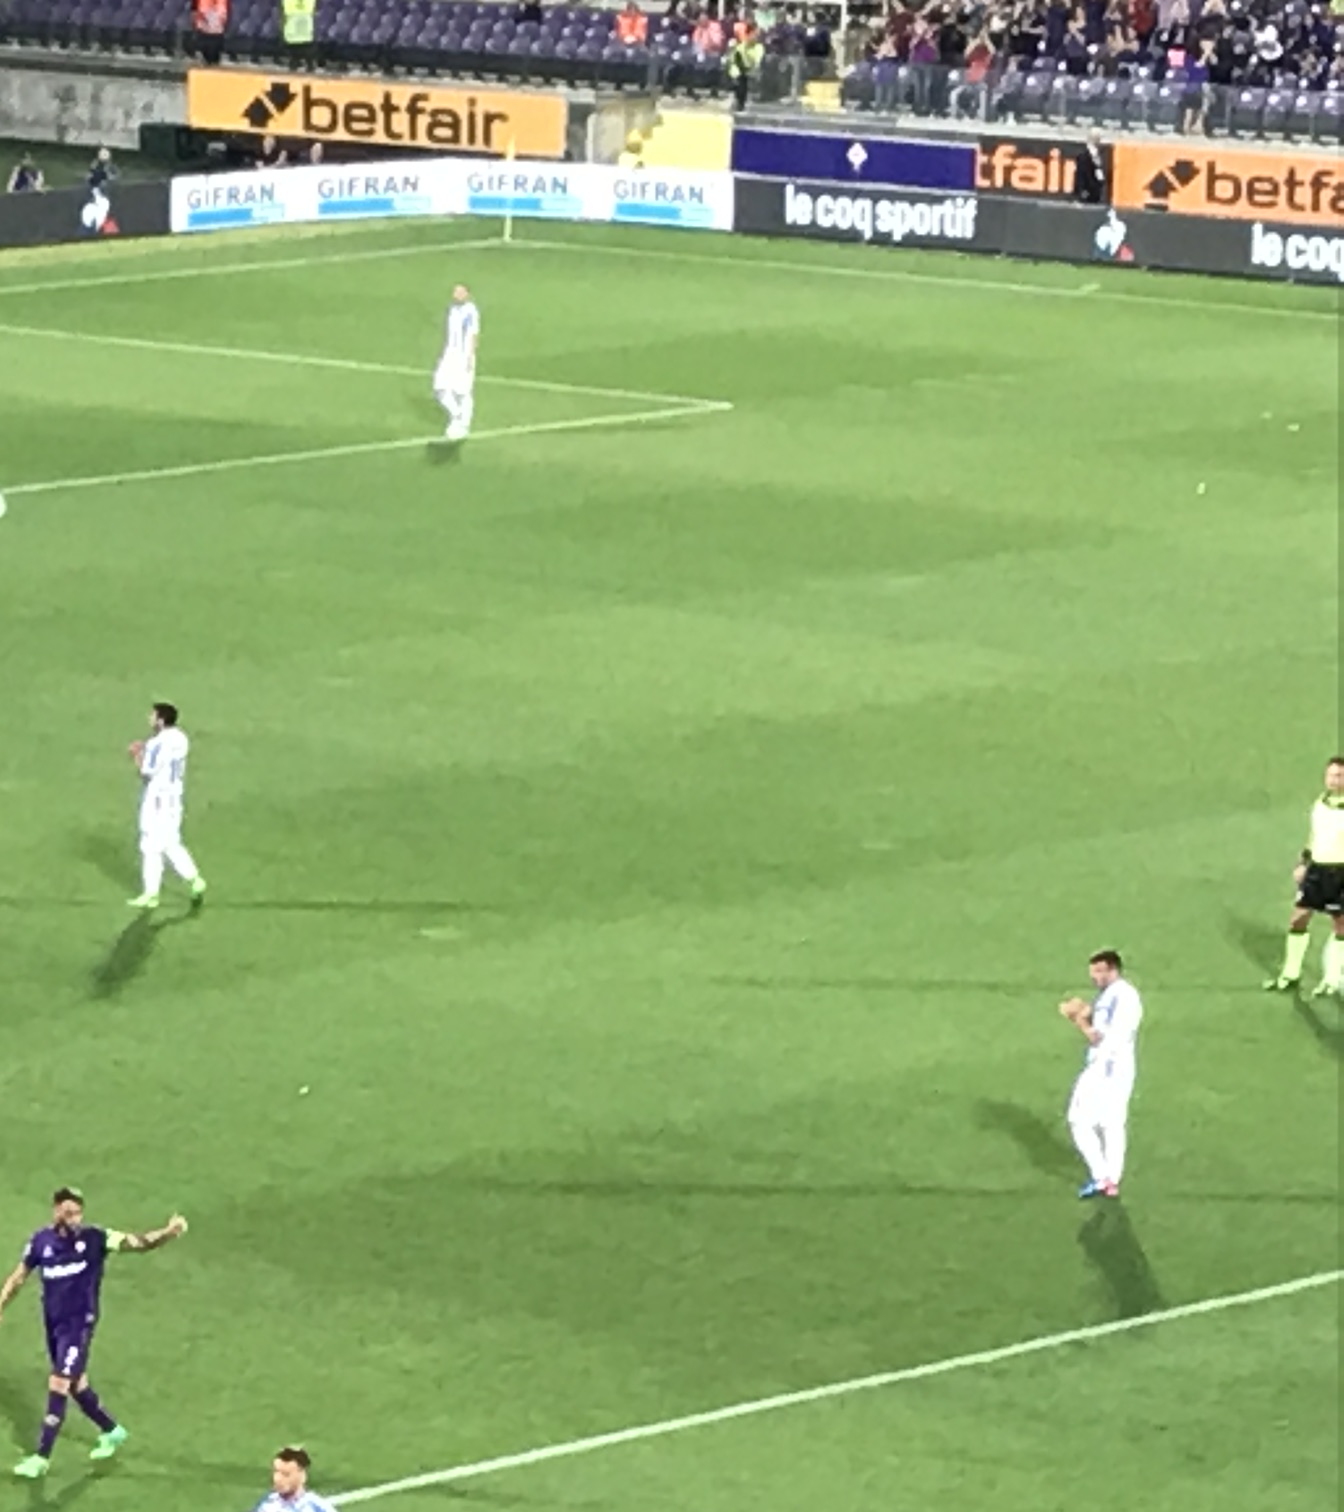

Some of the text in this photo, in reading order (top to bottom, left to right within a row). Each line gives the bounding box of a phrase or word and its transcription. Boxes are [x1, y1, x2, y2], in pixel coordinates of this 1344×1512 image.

[301, 83, 509, 147] betfair
[187, 181, 277, 210] GIFRAN
[317, 174, 420, 199] GIFRAN
[466, 171, 569, 196] GIFRAN
[613, 177, 705, 206] GIFRAN
[785, 185, 978, 242] le coq sportif
[1251, 222, 1283, 267] le
